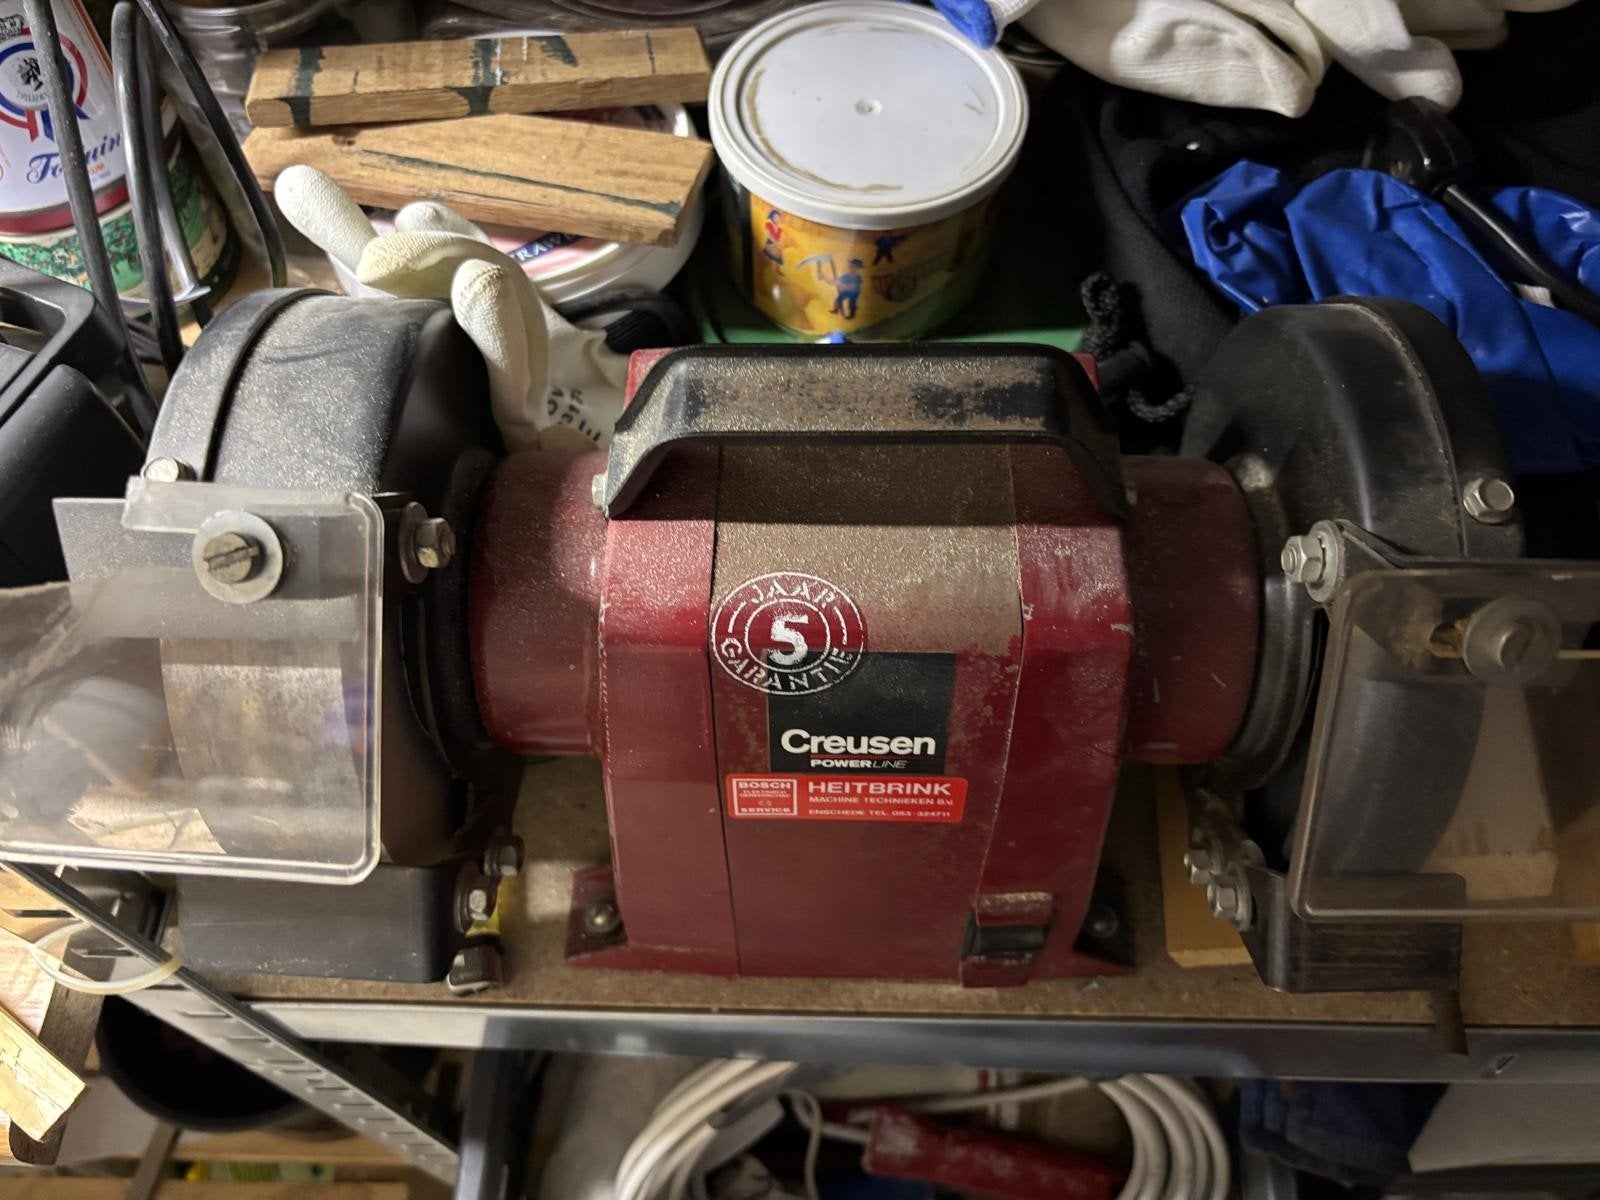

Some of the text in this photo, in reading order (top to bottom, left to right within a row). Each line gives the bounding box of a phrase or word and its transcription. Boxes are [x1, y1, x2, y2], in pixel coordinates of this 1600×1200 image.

[750, 579, 835, 608] JAAR
[768, 614, 809, 666] 5
[720, 637, 854, 690] GARANTIE
[780, 728, 936, 755] Creusen
[738, 781, 791, 789] BOSCH
[808, 781, 952, 796] HEITBRINK
[864, 797, 935, 805] TECHNIEKEN
